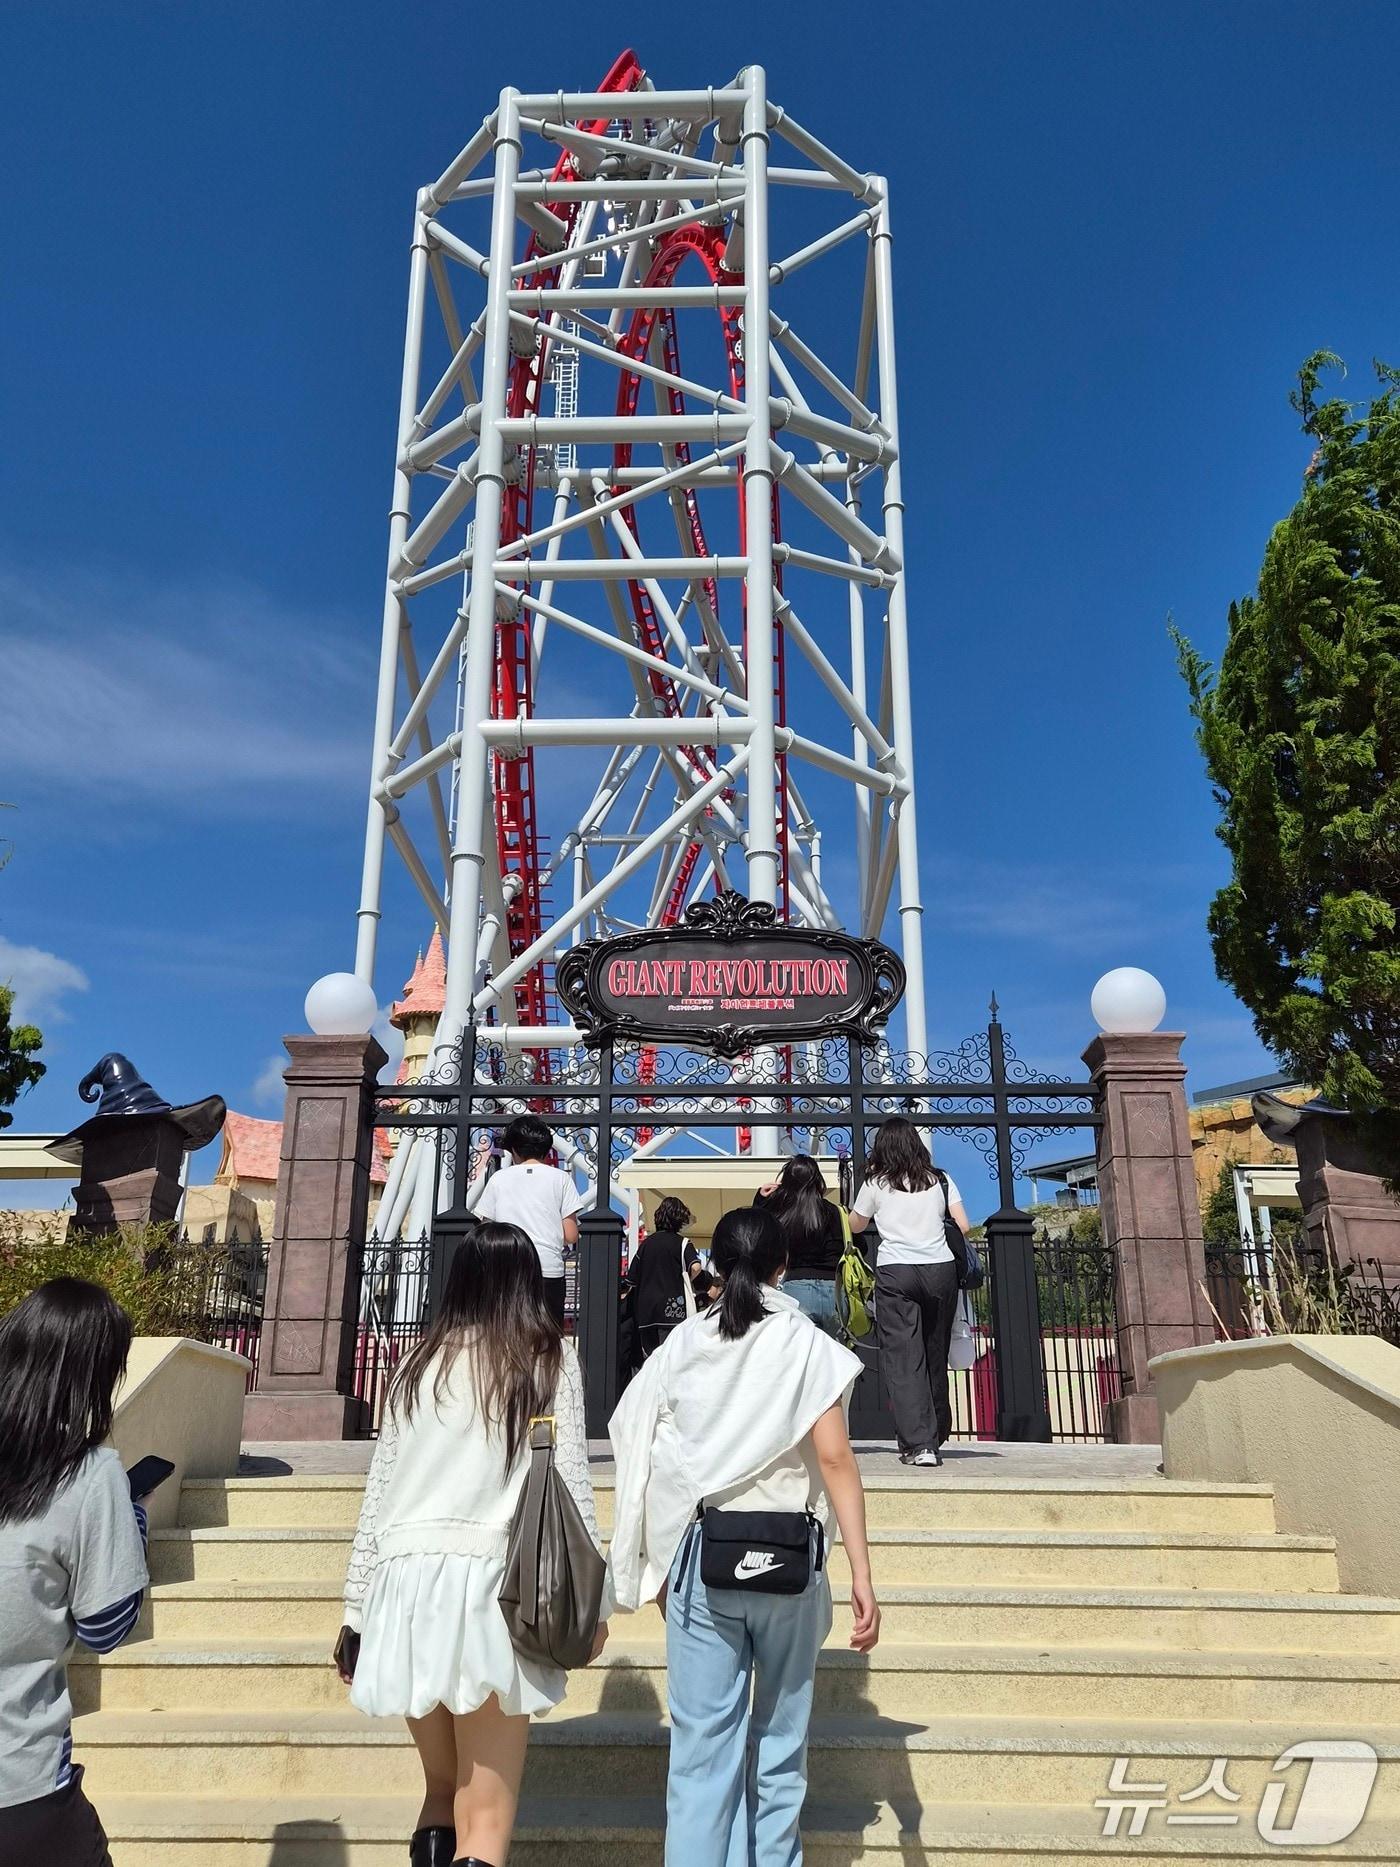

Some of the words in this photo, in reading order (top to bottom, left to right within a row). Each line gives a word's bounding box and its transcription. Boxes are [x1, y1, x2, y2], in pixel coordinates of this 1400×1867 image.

[608, 960, 686, 996] GIANT
[688, 959, 849, 996] REVOLUTION
[742, 1551, 775, 1568] NIKE
